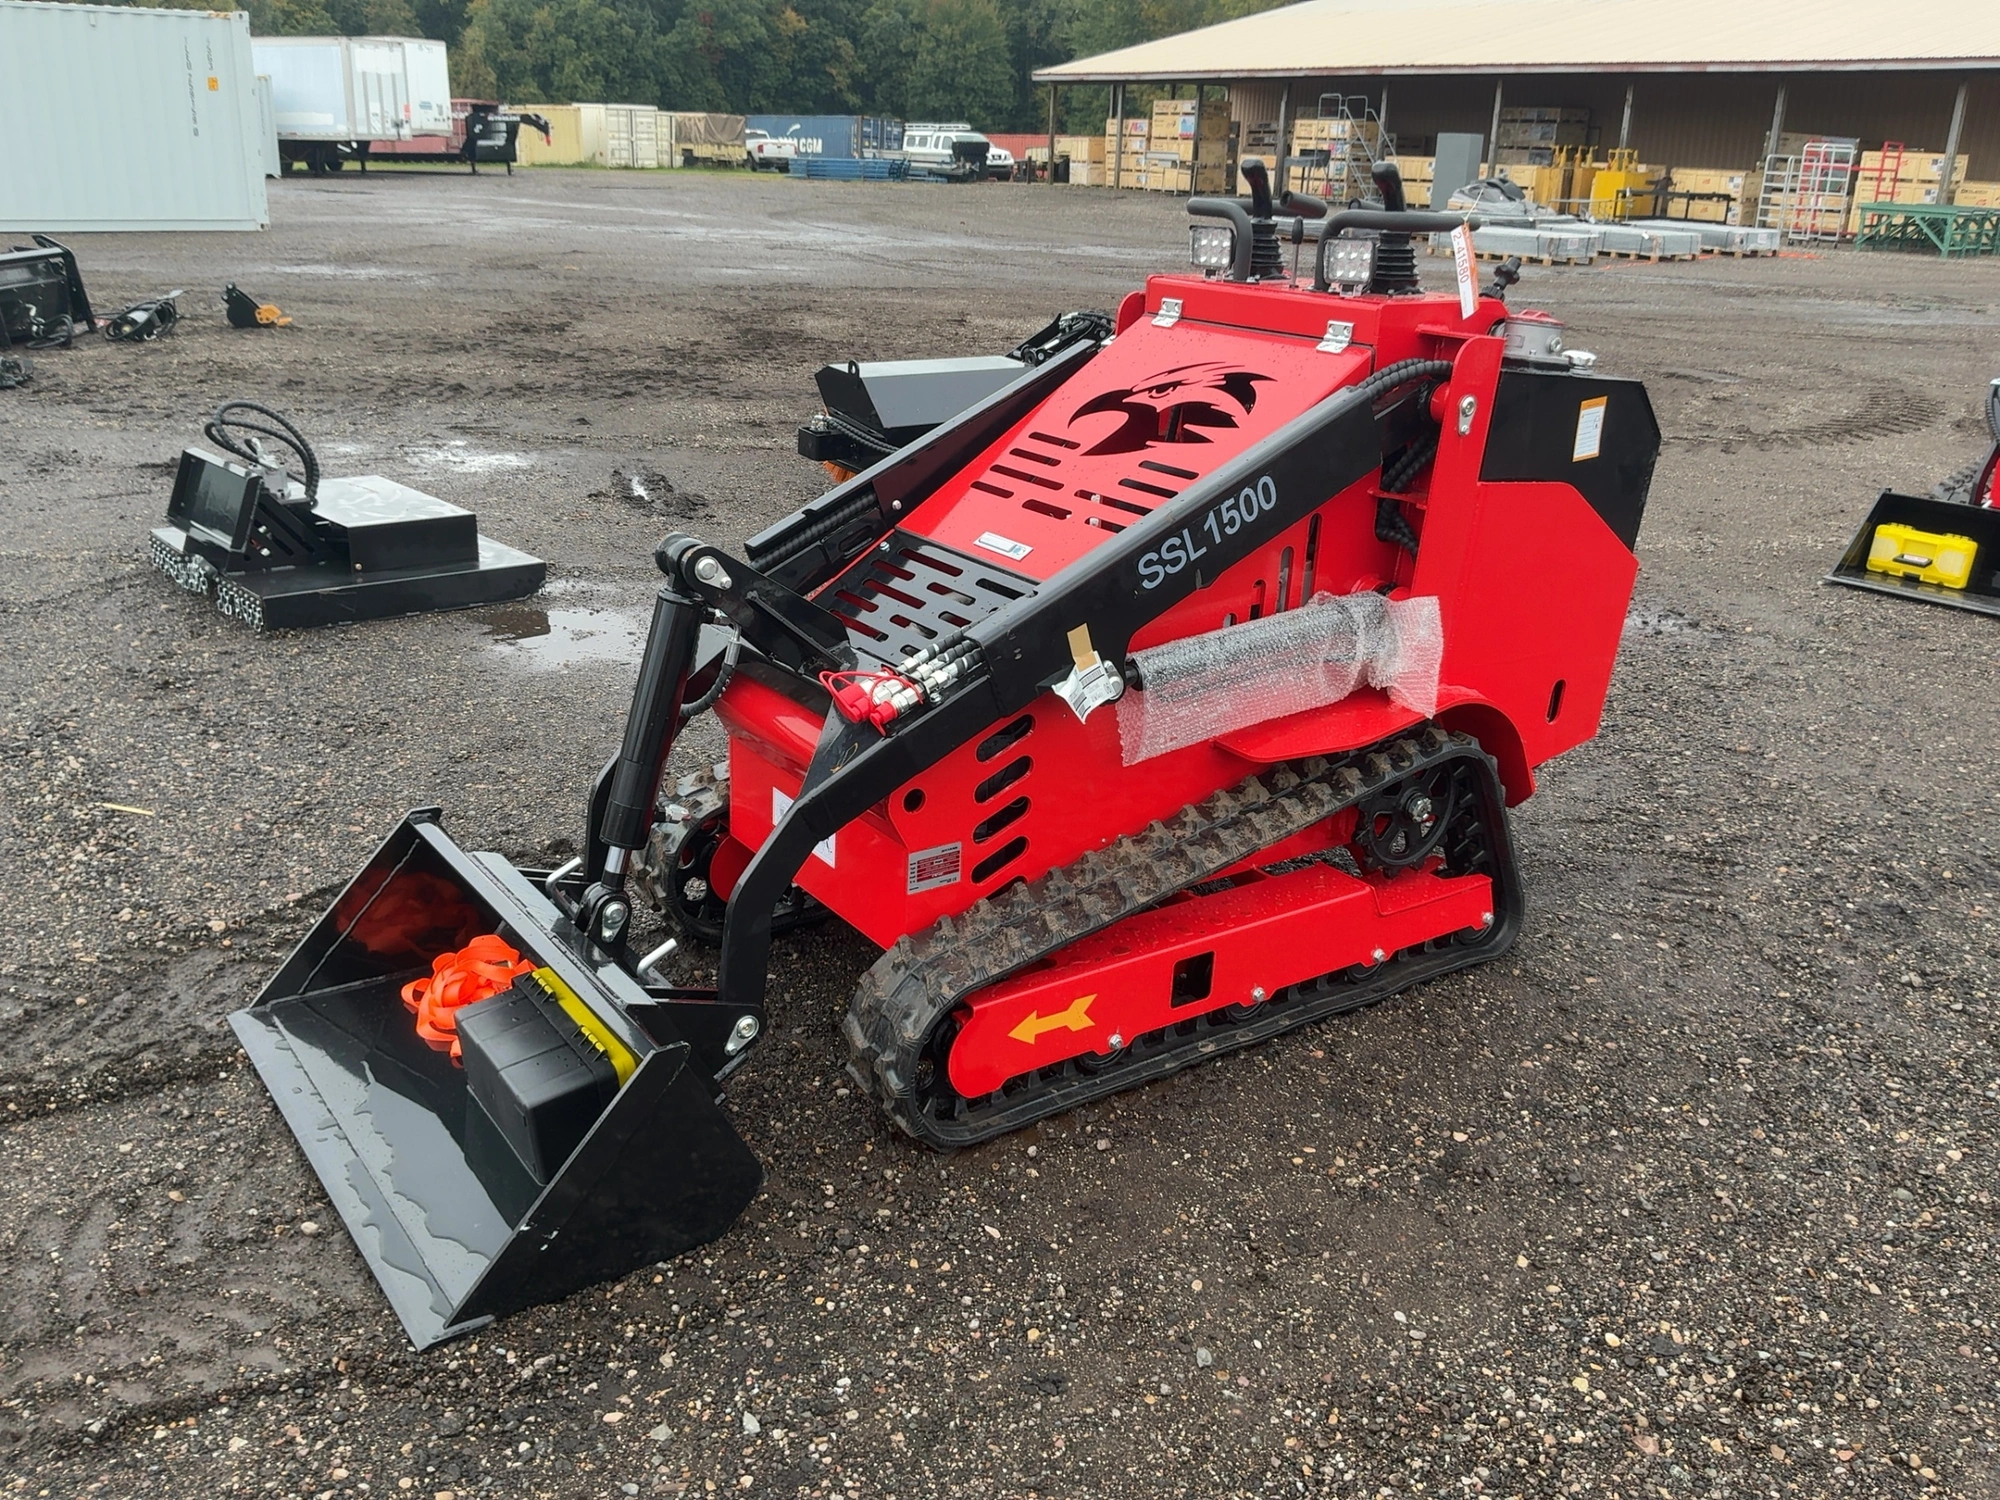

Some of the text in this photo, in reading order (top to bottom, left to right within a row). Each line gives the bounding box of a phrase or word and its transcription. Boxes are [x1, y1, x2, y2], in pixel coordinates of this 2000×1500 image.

[799, 136, 823, 153] CGM
[1452, 232, 1470, 284] 2-41580
[1137, 474, 1278, 590] SSL 1500
